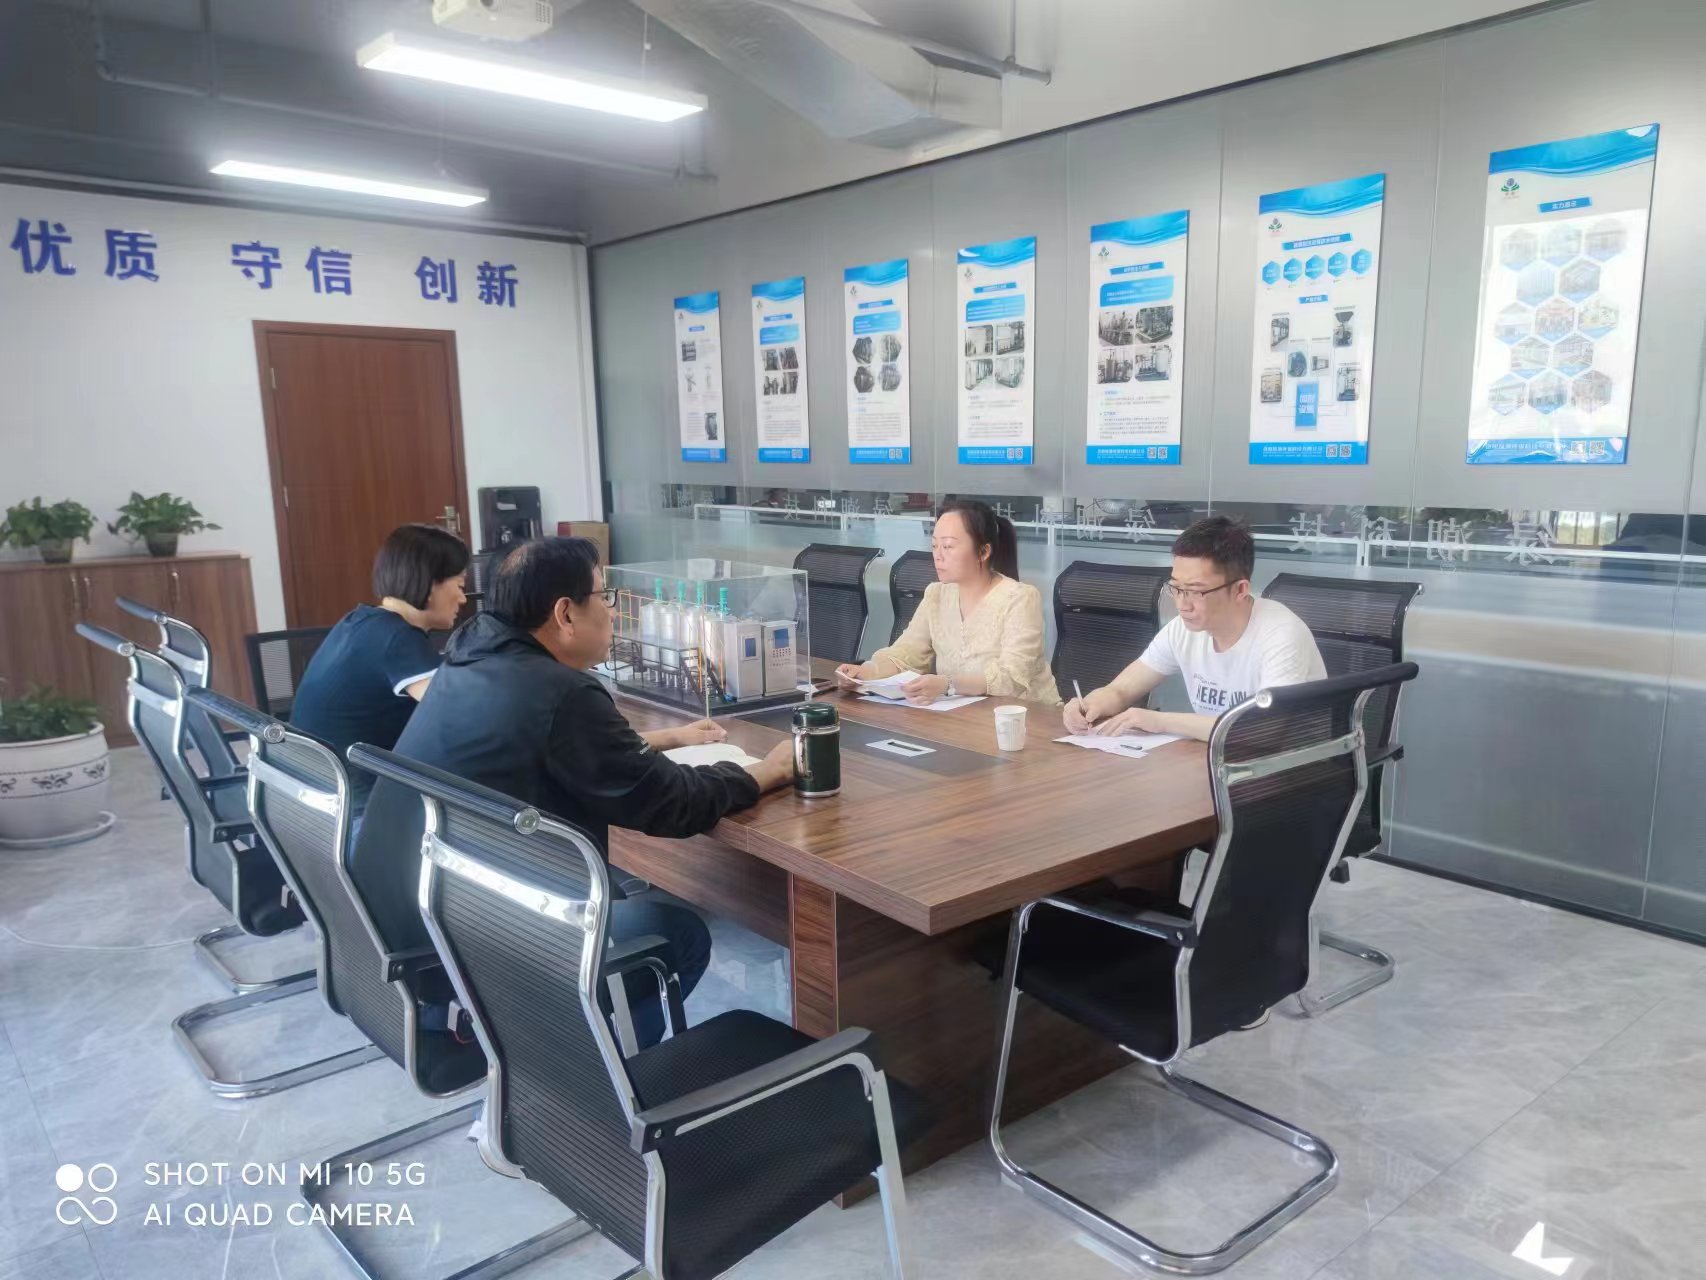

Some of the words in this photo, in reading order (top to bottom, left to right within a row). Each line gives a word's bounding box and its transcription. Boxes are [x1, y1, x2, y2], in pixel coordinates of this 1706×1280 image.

[11, 218, 160, 281] 优质
[231, 241, 353, 295] 守信
[415, 257, 518, 308] 创新
